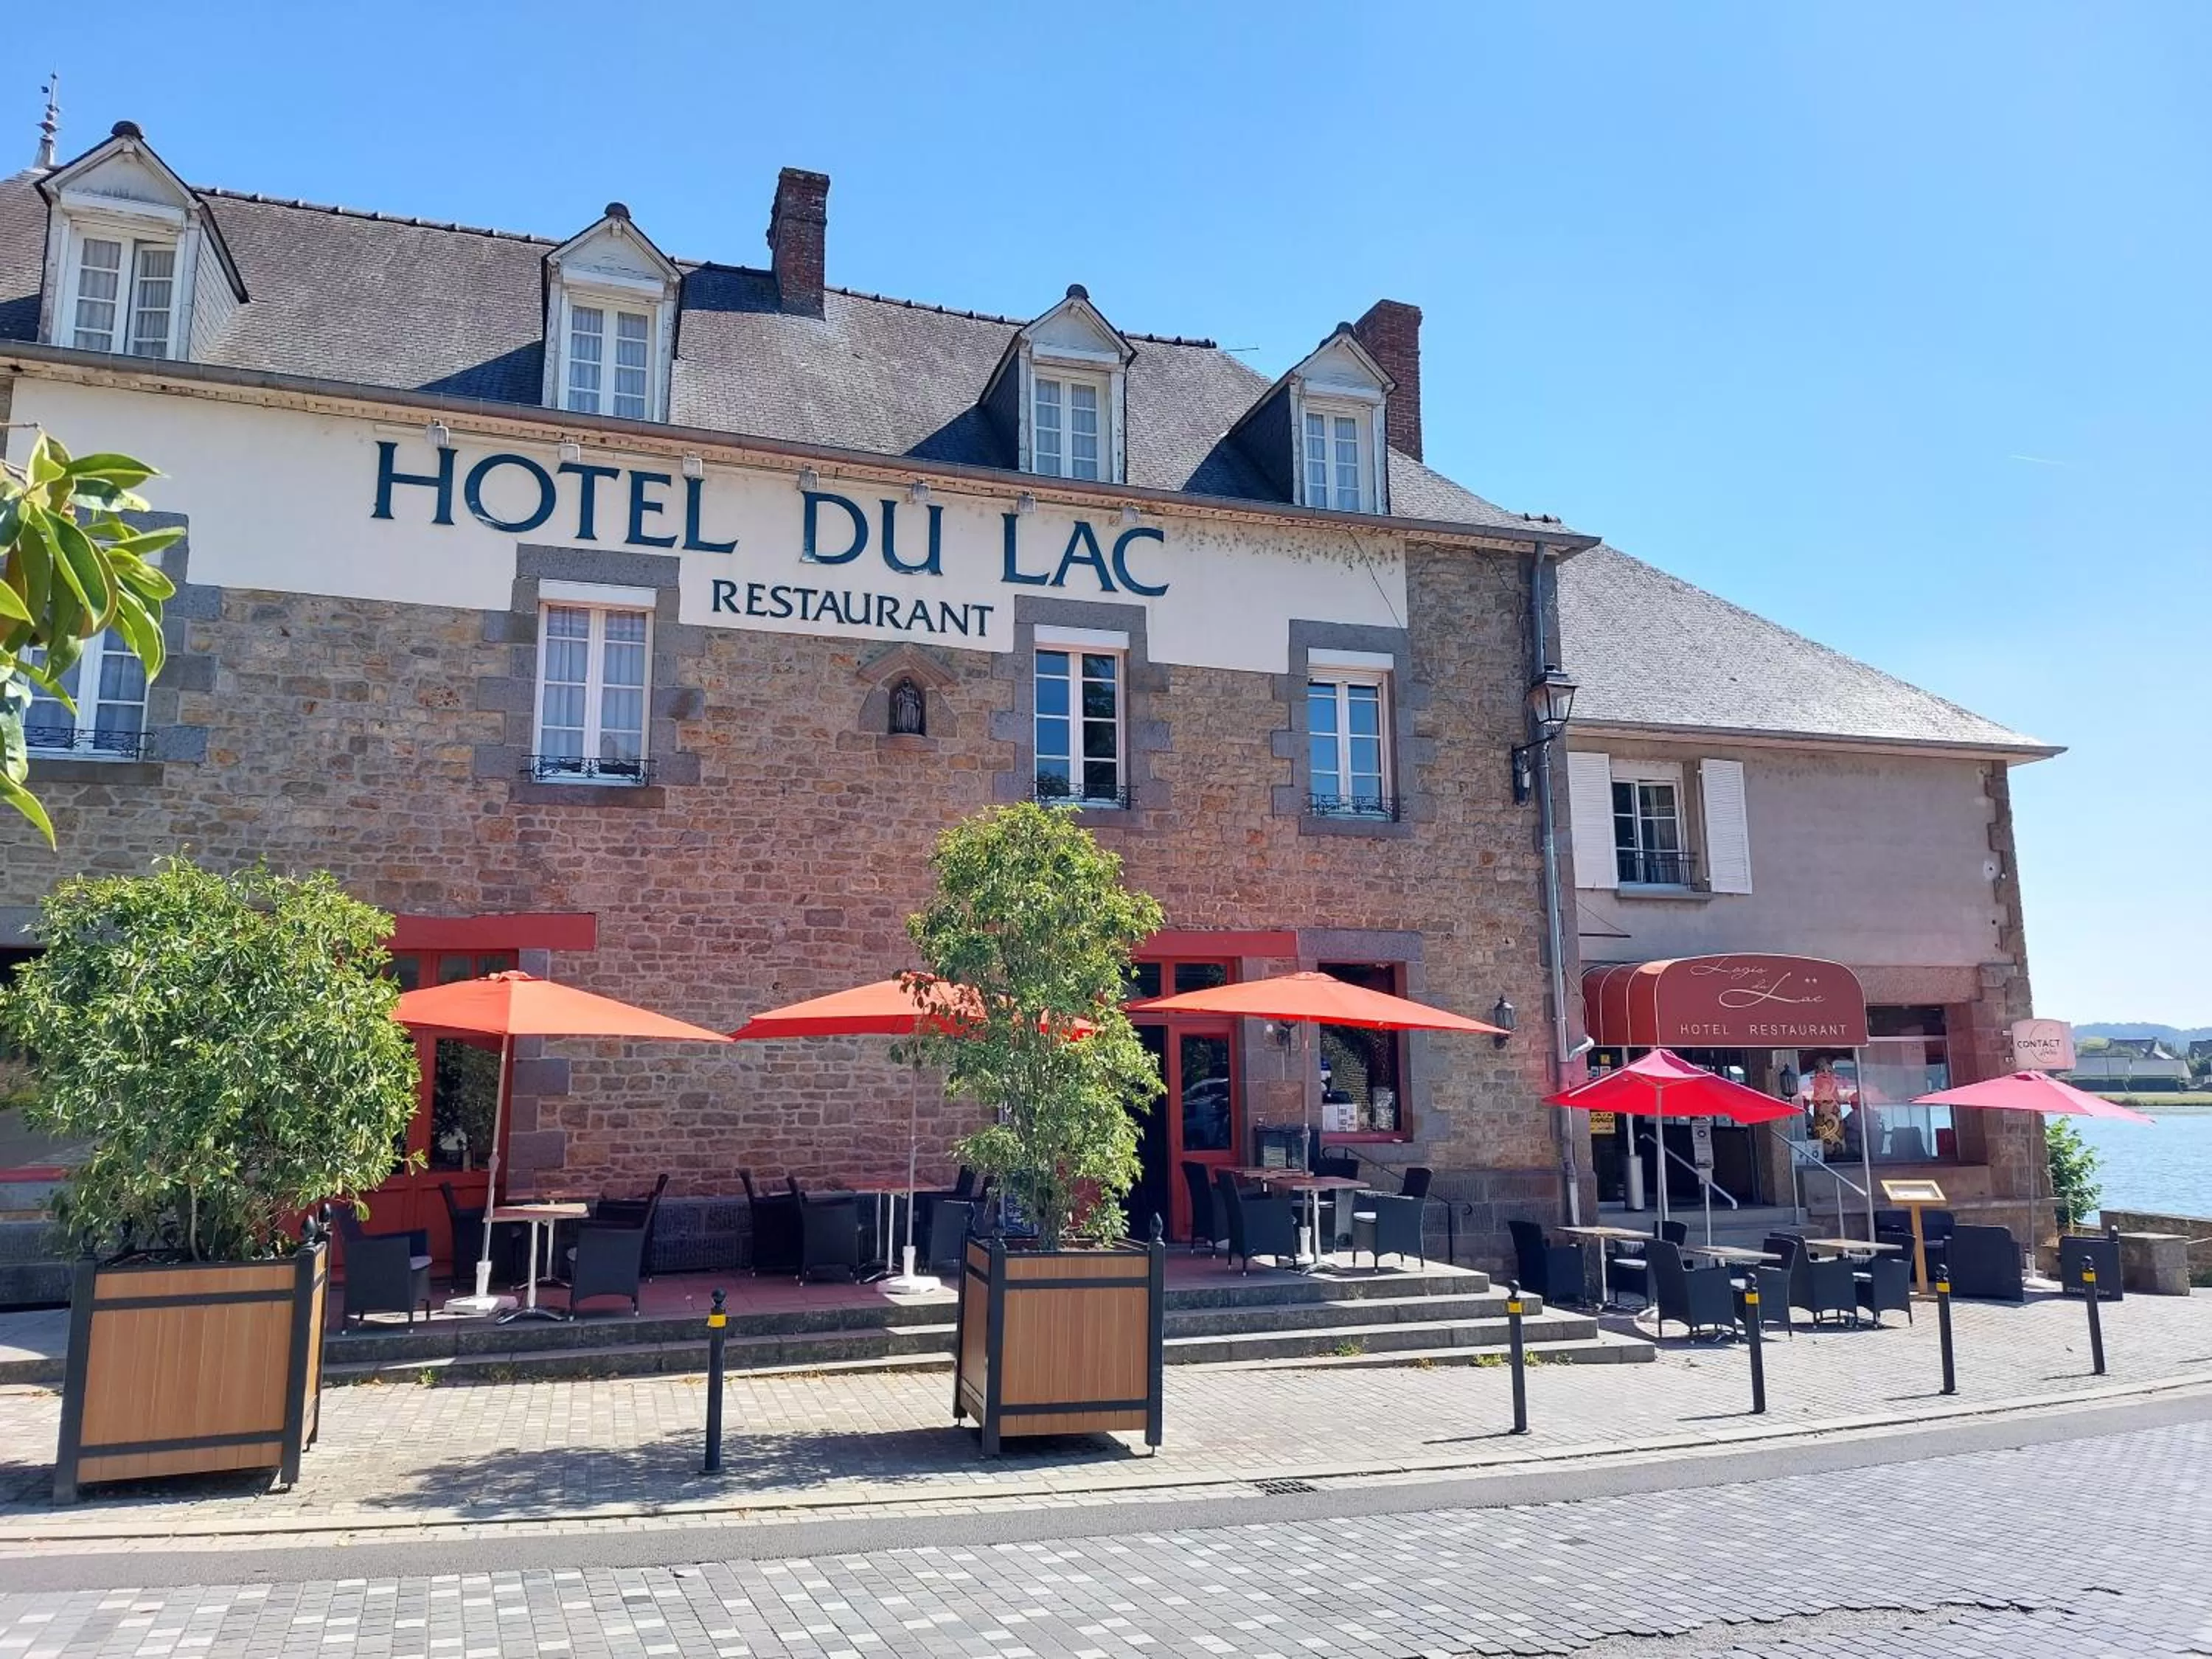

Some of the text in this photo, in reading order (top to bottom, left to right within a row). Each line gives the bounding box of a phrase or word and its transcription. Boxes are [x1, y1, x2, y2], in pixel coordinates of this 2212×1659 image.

[372, 440, 1169, 597] HOTEL DU LAC
[712, 579, 995, 637] RESTAURANT
[1719, 971, 1826, 1009] Lac
[1680, 1023, 1848, 1037] HOTEL RESTAURANT
[2017, 1039, 2060, 1048] CONTACT
